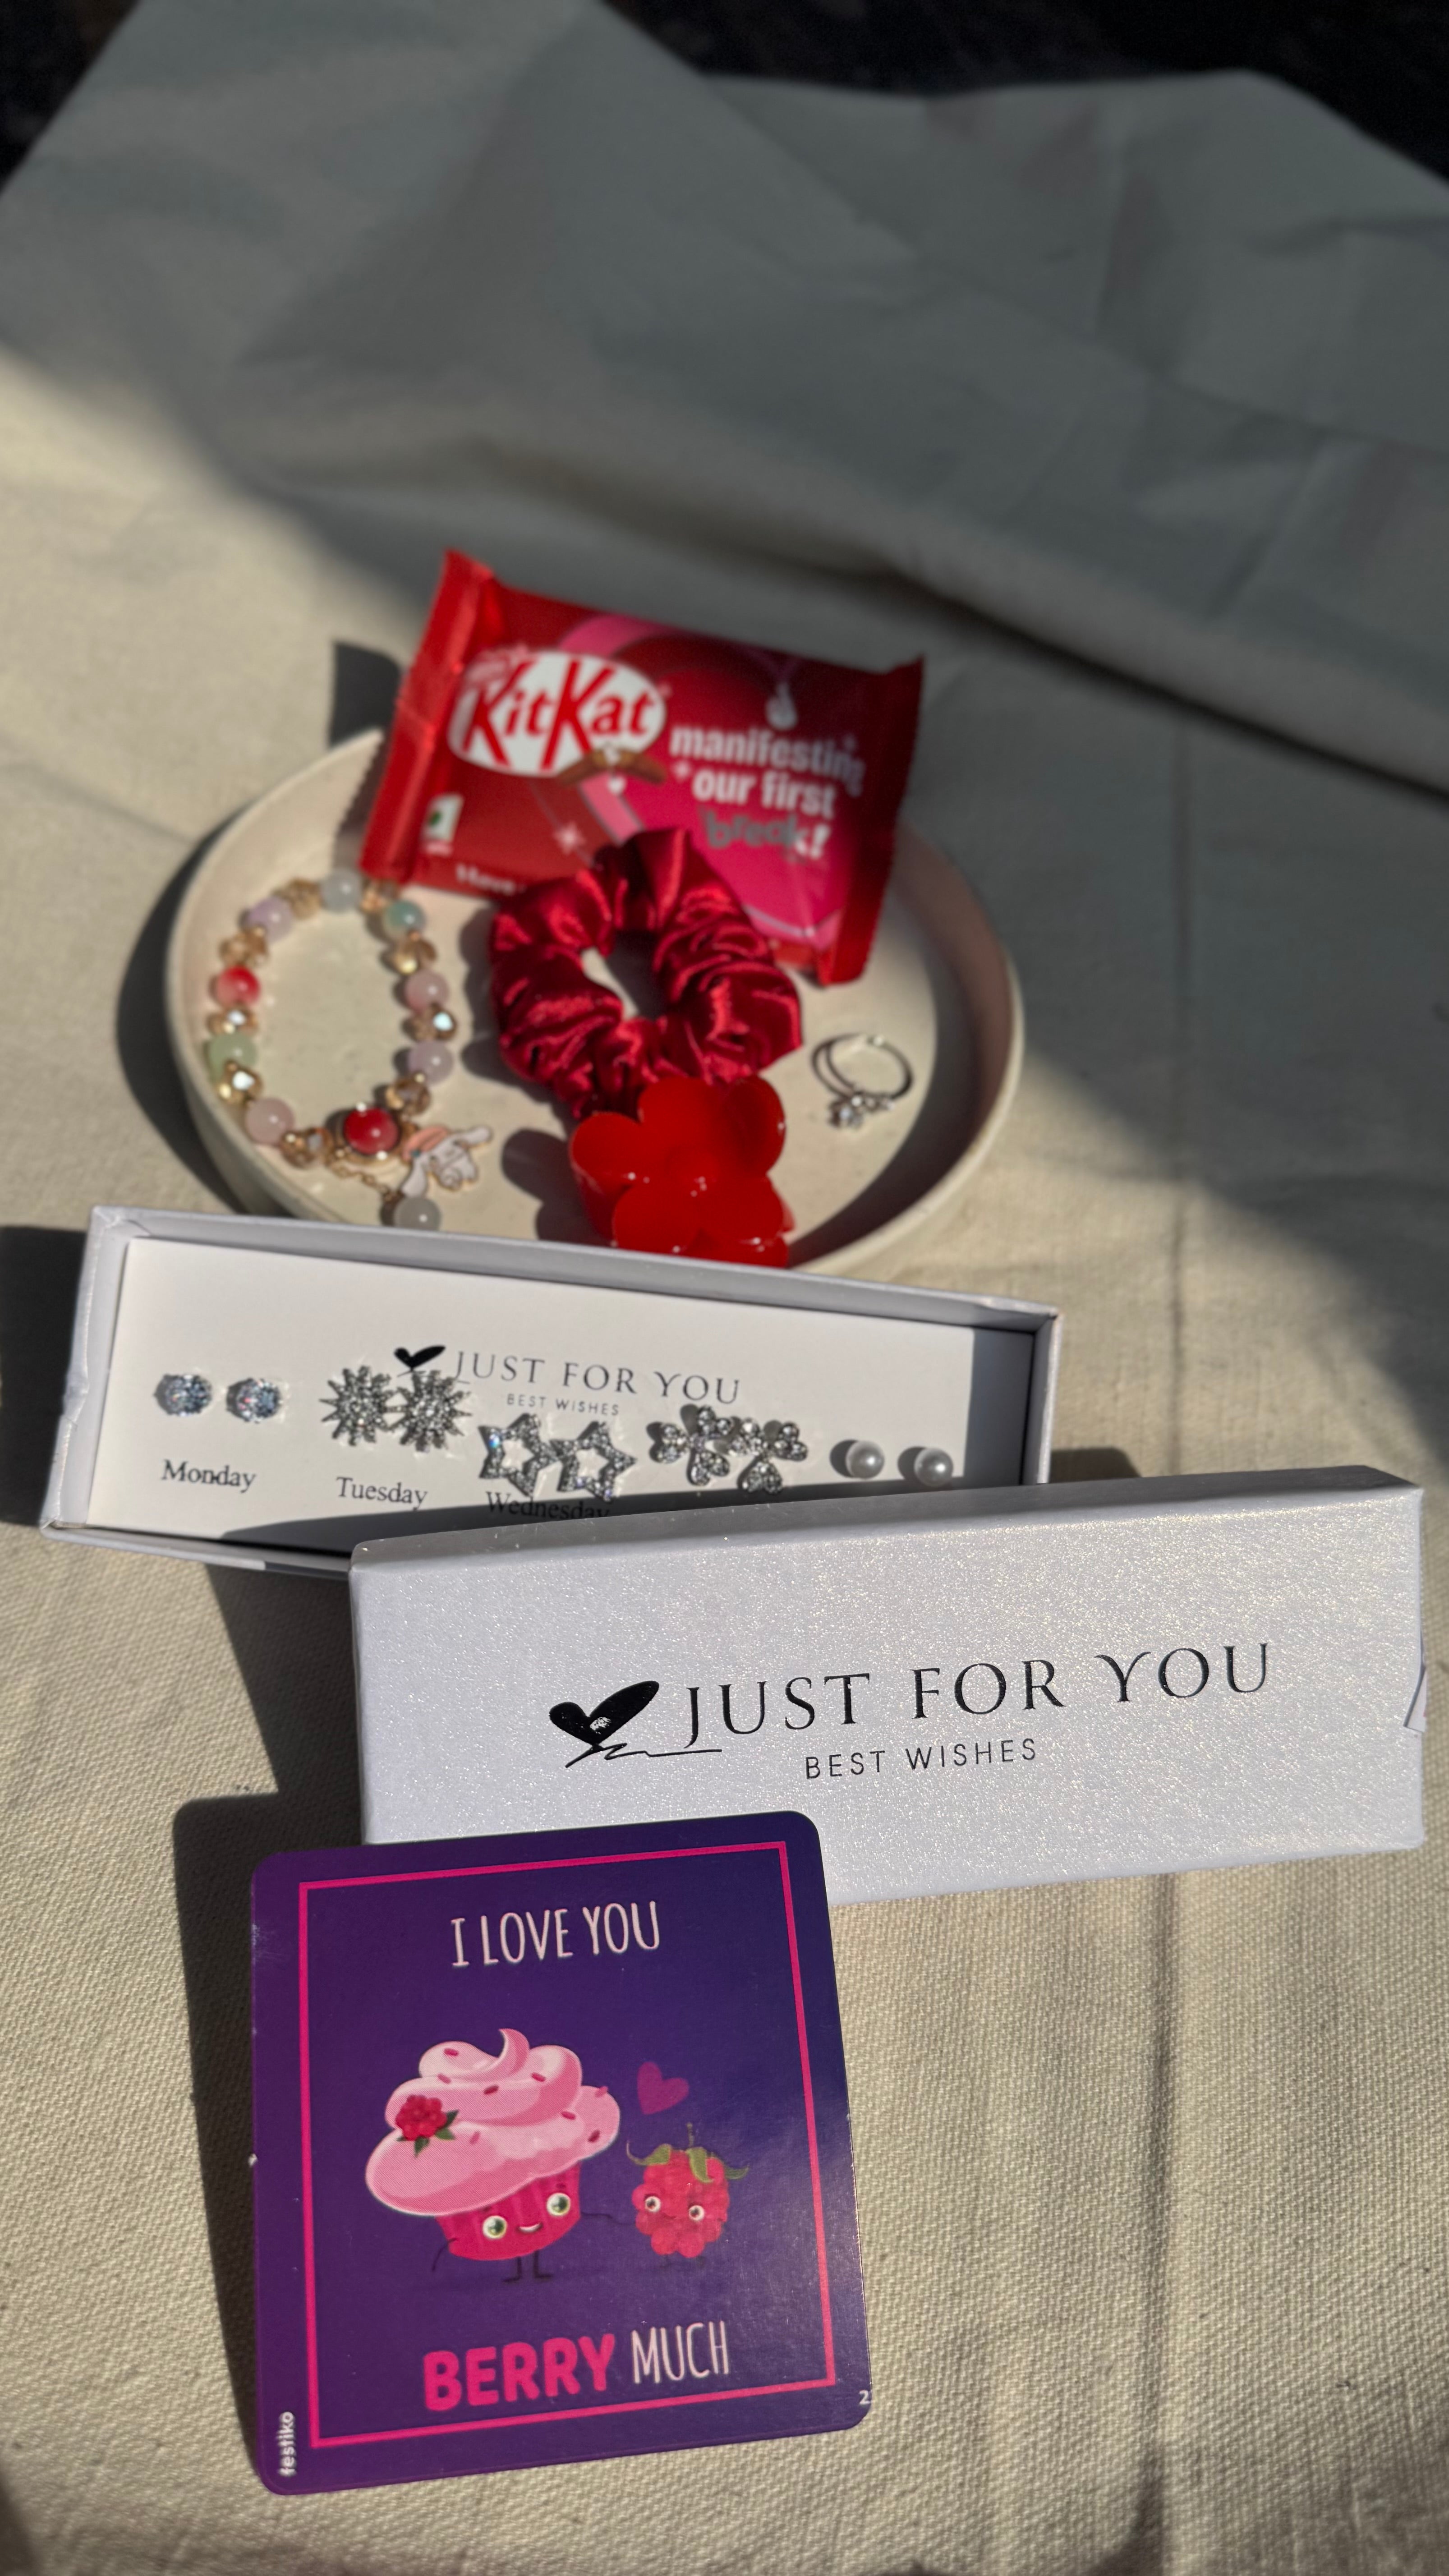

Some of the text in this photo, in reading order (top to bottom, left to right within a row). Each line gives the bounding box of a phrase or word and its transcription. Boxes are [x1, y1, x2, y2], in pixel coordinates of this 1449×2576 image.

[461, 658, 654, 769] KitKat
[669, 725, 865, 797] manifesting
[692, 768, 835, 821] our first
[452, 1352, 740, 1404] JUST FOR YOU
[506, 1394, 620, 1415] BEST WISHES
[161, 1459, 256, 1493] Monday
[336, 1477, 428, 1510] Tuesday
[684, 1643, 1268, 1748] JUST FOR YOU
[805, 1738, 1036, 1780] BEST WISHES
[451, 1900, 660, 1967] I LOVE YOU
[423, 2320, 729, 2411] BERRY MUCH
[276, 2411, 296, 2477] festiko
